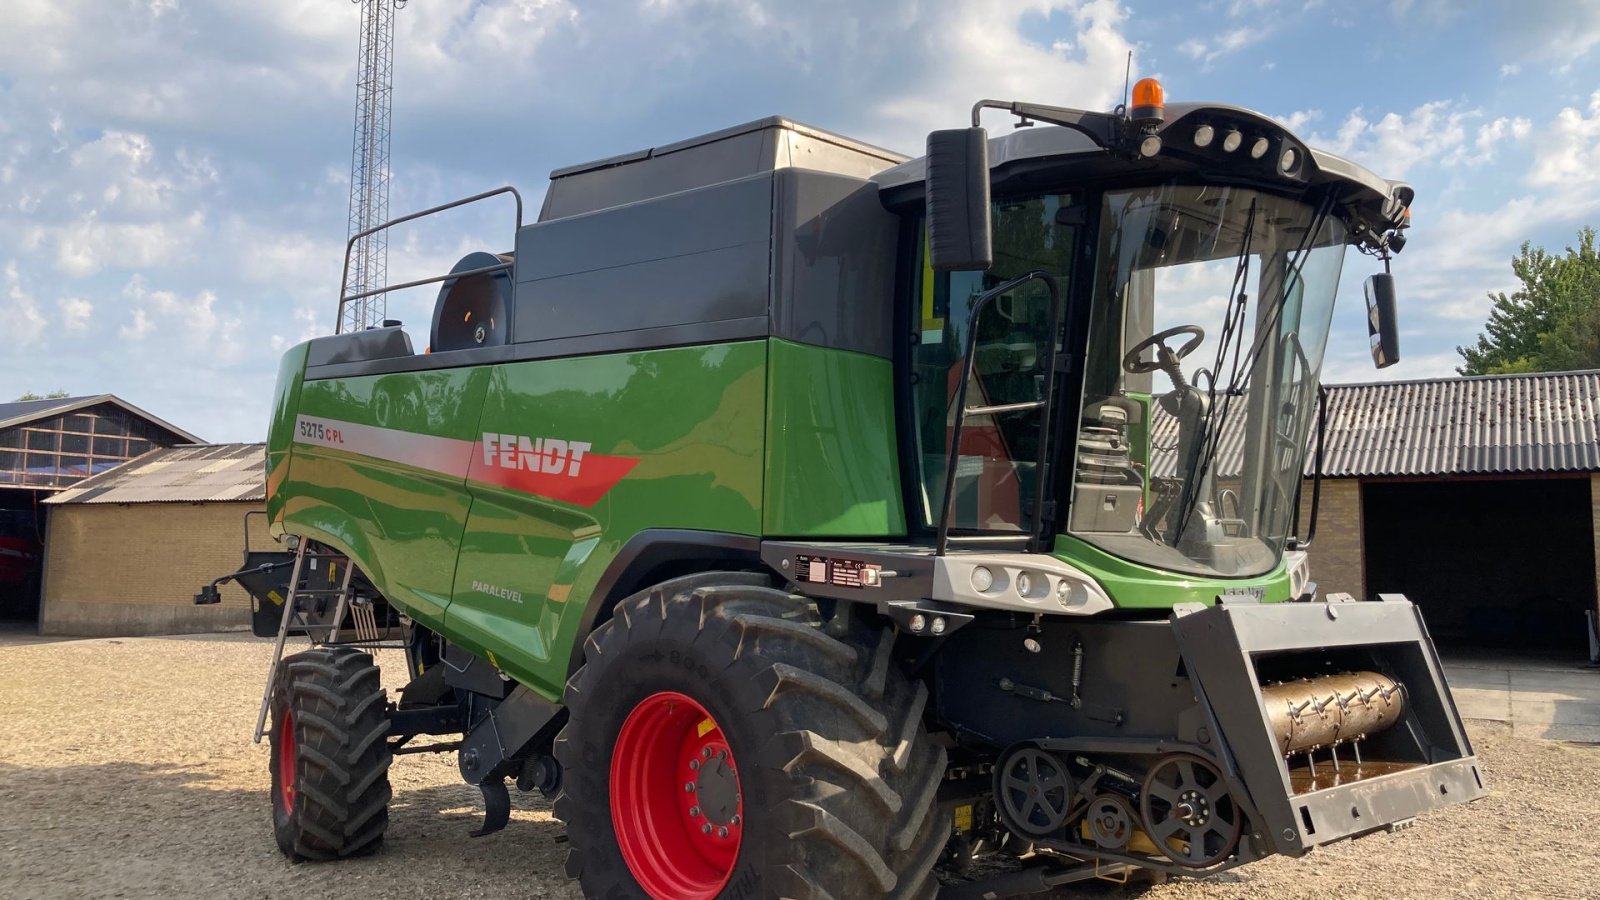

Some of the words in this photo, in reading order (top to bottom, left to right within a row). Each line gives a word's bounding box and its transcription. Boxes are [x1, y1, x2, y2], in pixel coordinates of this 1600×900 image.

[300, 420, 324, 440] 5275
[482, 431, 593, 478] FENDT
[471, 579, 524, 604] PARALEVEL
